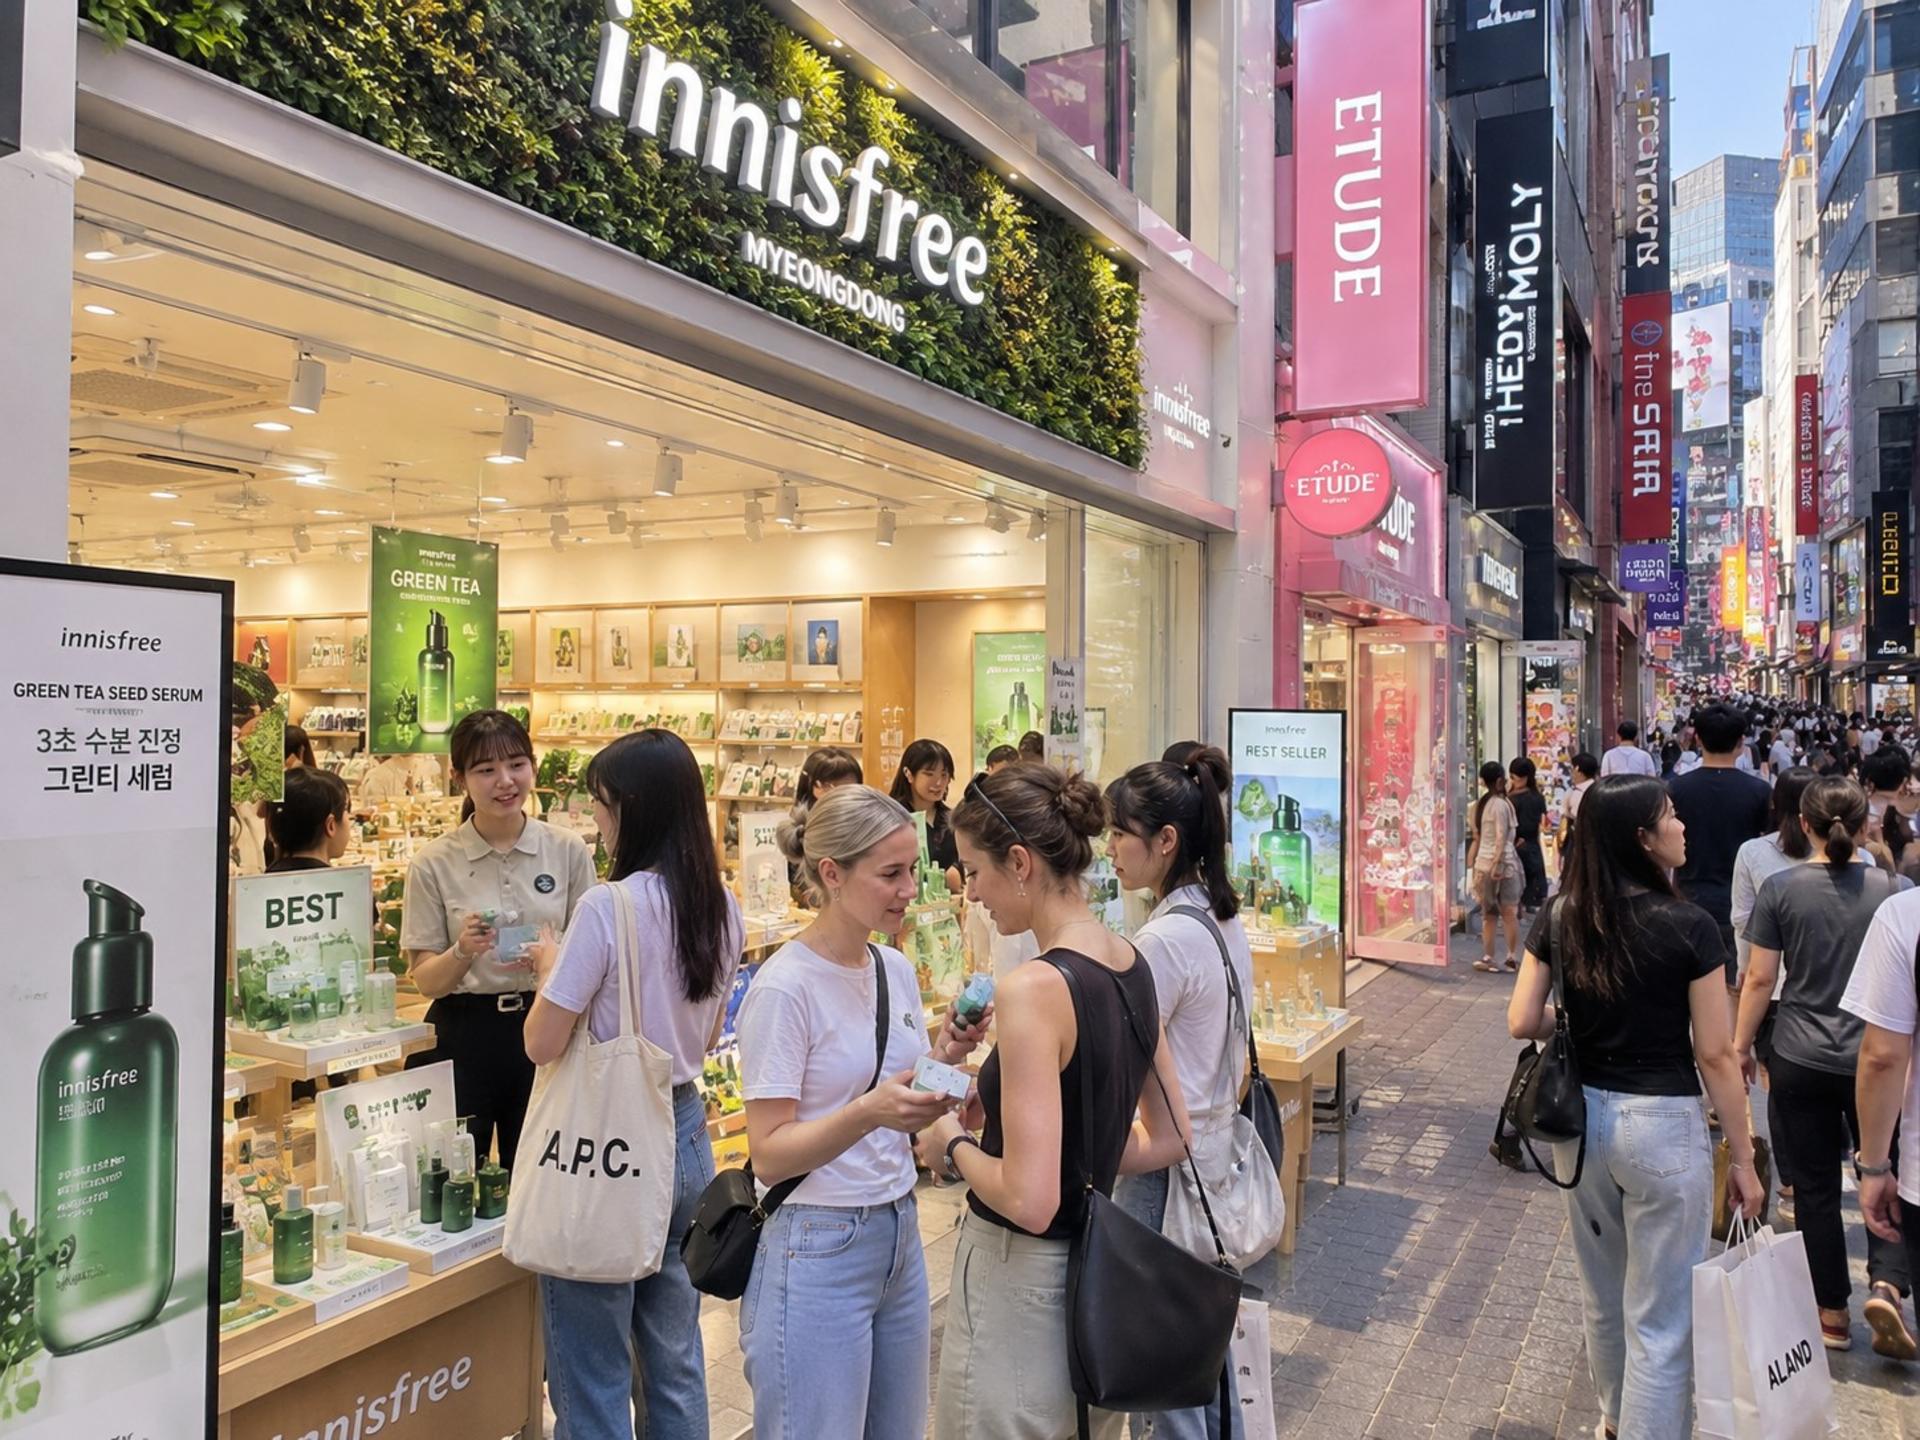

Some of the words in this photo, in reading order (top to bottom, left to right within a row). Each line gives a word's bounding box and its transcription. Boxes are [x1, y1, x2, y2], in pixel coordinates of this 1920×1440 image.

[591, 0, 988, 305] innisfree
[1333, 91, 1382, 303] ETUDE
[742, 231, 906, 333] MYEONGDONG
[1296, 473, 1377, 497] ETUDE
[390, 569, 447, 592] GREEN
[451, 576, 481, 596] TEA
[60, 627, 162, 653] innisfree
[13, 682, 70, 699] GREEN
[74, 685, 105, 700] TEA
[108, 686, 148, 701] SEED
[151, 687, 203, 703] SERUM
[36, 728, 76, 755] 3초
[84, 728, 132, 756] 수분
[138, 728, 182, 756] 진정
[1281, 746, 1328, 760] SELLER
[43, 764, 119, 793] 그린티
[128, 763, 173, 792] 세럼
[265, 891, 344, 929] BEST
[58, 1068, 139, 1099] innisfree
[538, 1130, 640, 1178] A.P.C.
[1768, 1339, 1812, 1391] ALAND
[272, 1355, 472, 1440] nisfree
